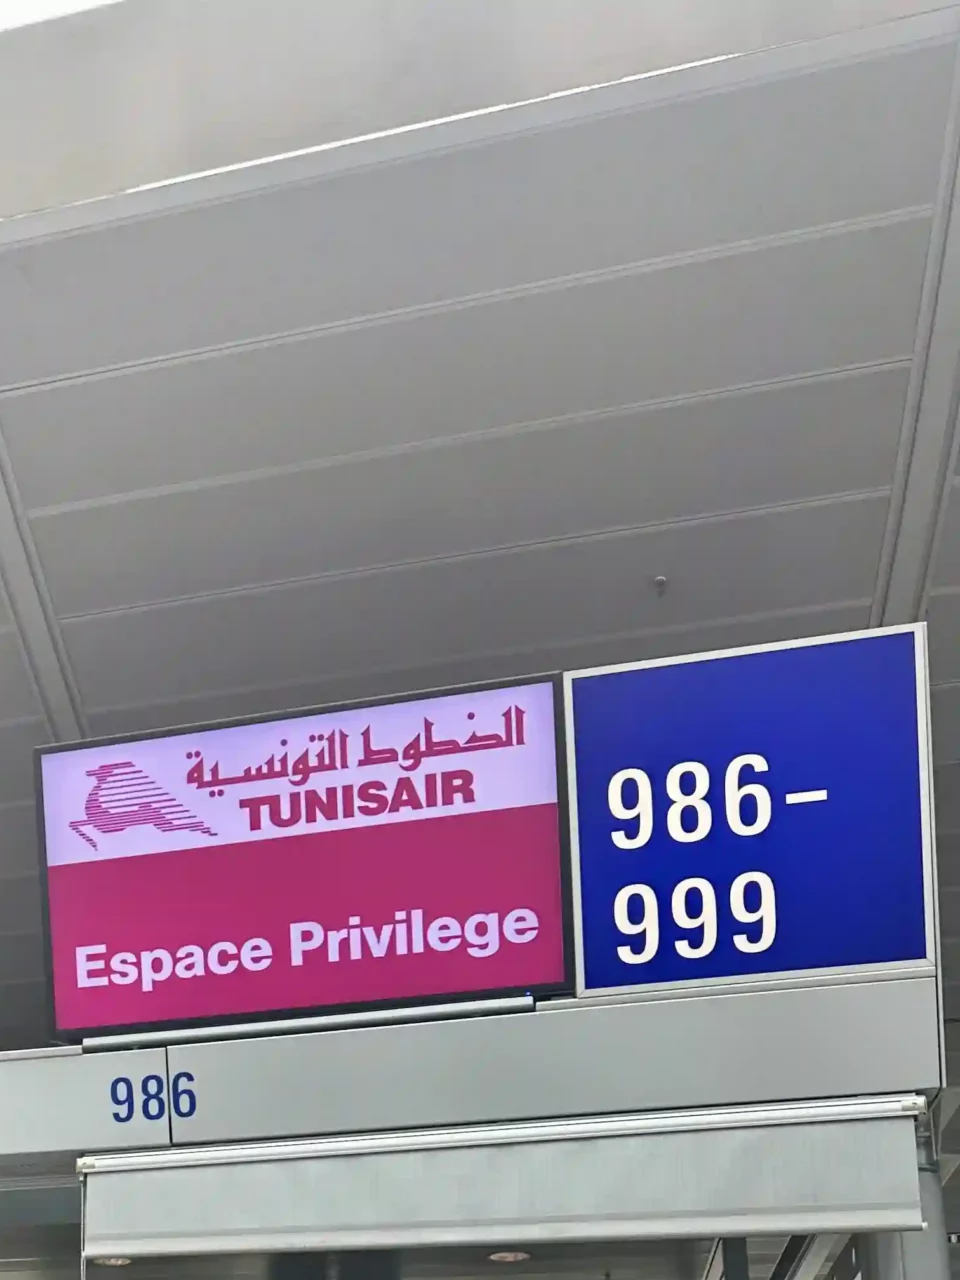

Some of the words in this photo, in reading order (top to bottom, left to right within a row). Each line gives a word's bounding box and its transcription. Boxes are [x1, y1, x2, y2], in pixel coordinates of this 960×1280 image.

[186, 728, 350, 798] التونسية
[239, 768, 477, 832] TUNISAIR
[607, 753, 829, 850] 986-
[74, 937, 273, 992] Espace
[289, 908, 539, 967] Privilege
[613, 871, 777, 965] 999
[110, 1071, 197, 1124] 986
